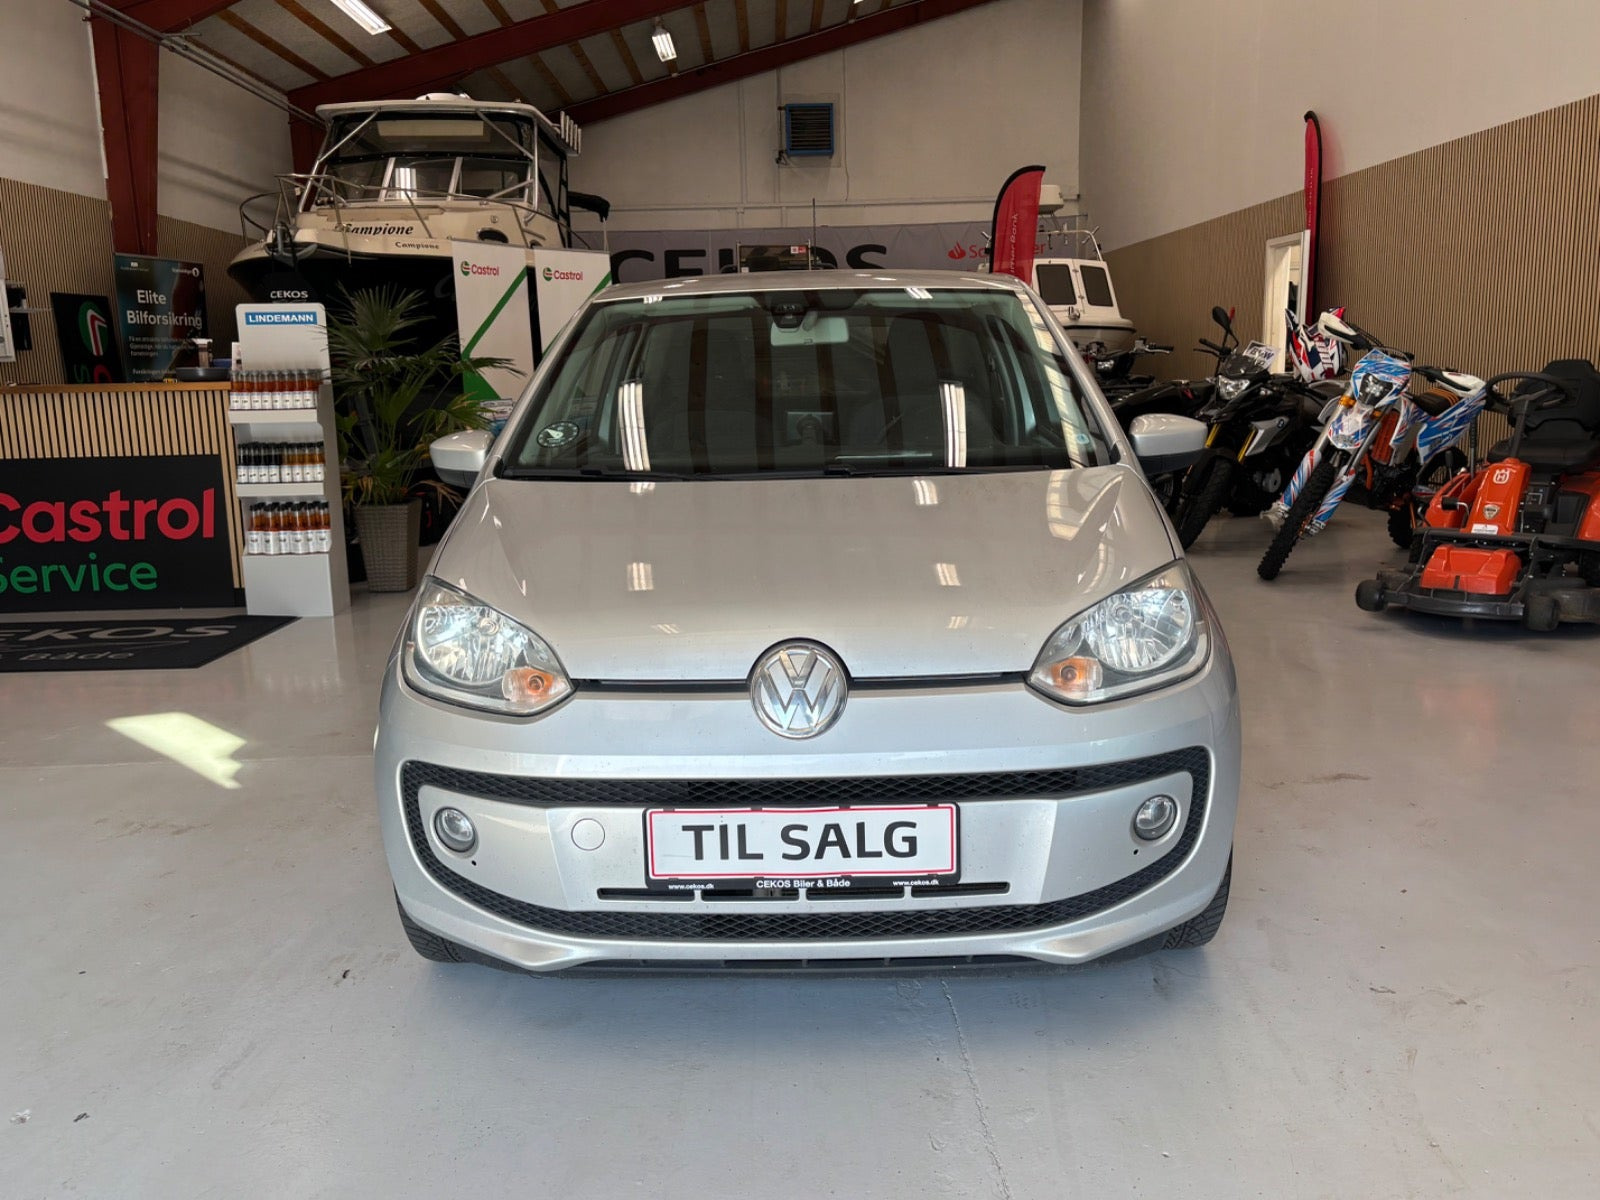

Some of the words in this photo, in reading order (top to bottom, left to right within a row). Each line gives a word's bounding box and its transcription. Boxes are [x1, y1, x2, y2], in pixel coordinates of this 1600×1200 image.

[395, 241, 439, 250] Campione
[471, 264, 499, 276] Castrol
[553, 270, 583, 281] Castrol
[137, 289, 167, 304] Elite
[270, 290, 308, 299] CEKOS
[126, 310, 202, 330] Bilforsikring
[249, 313, 314, 323] LINDEMANN
[682, 824, 764, 861] TIL
[780, 821, 918, 861] SALG
[756, 880, 791, 888] CEKOS
[793, 879, 815, 889] Biler
[816, 879, 825, 888] &
[826, 878, 850, 888] Både
